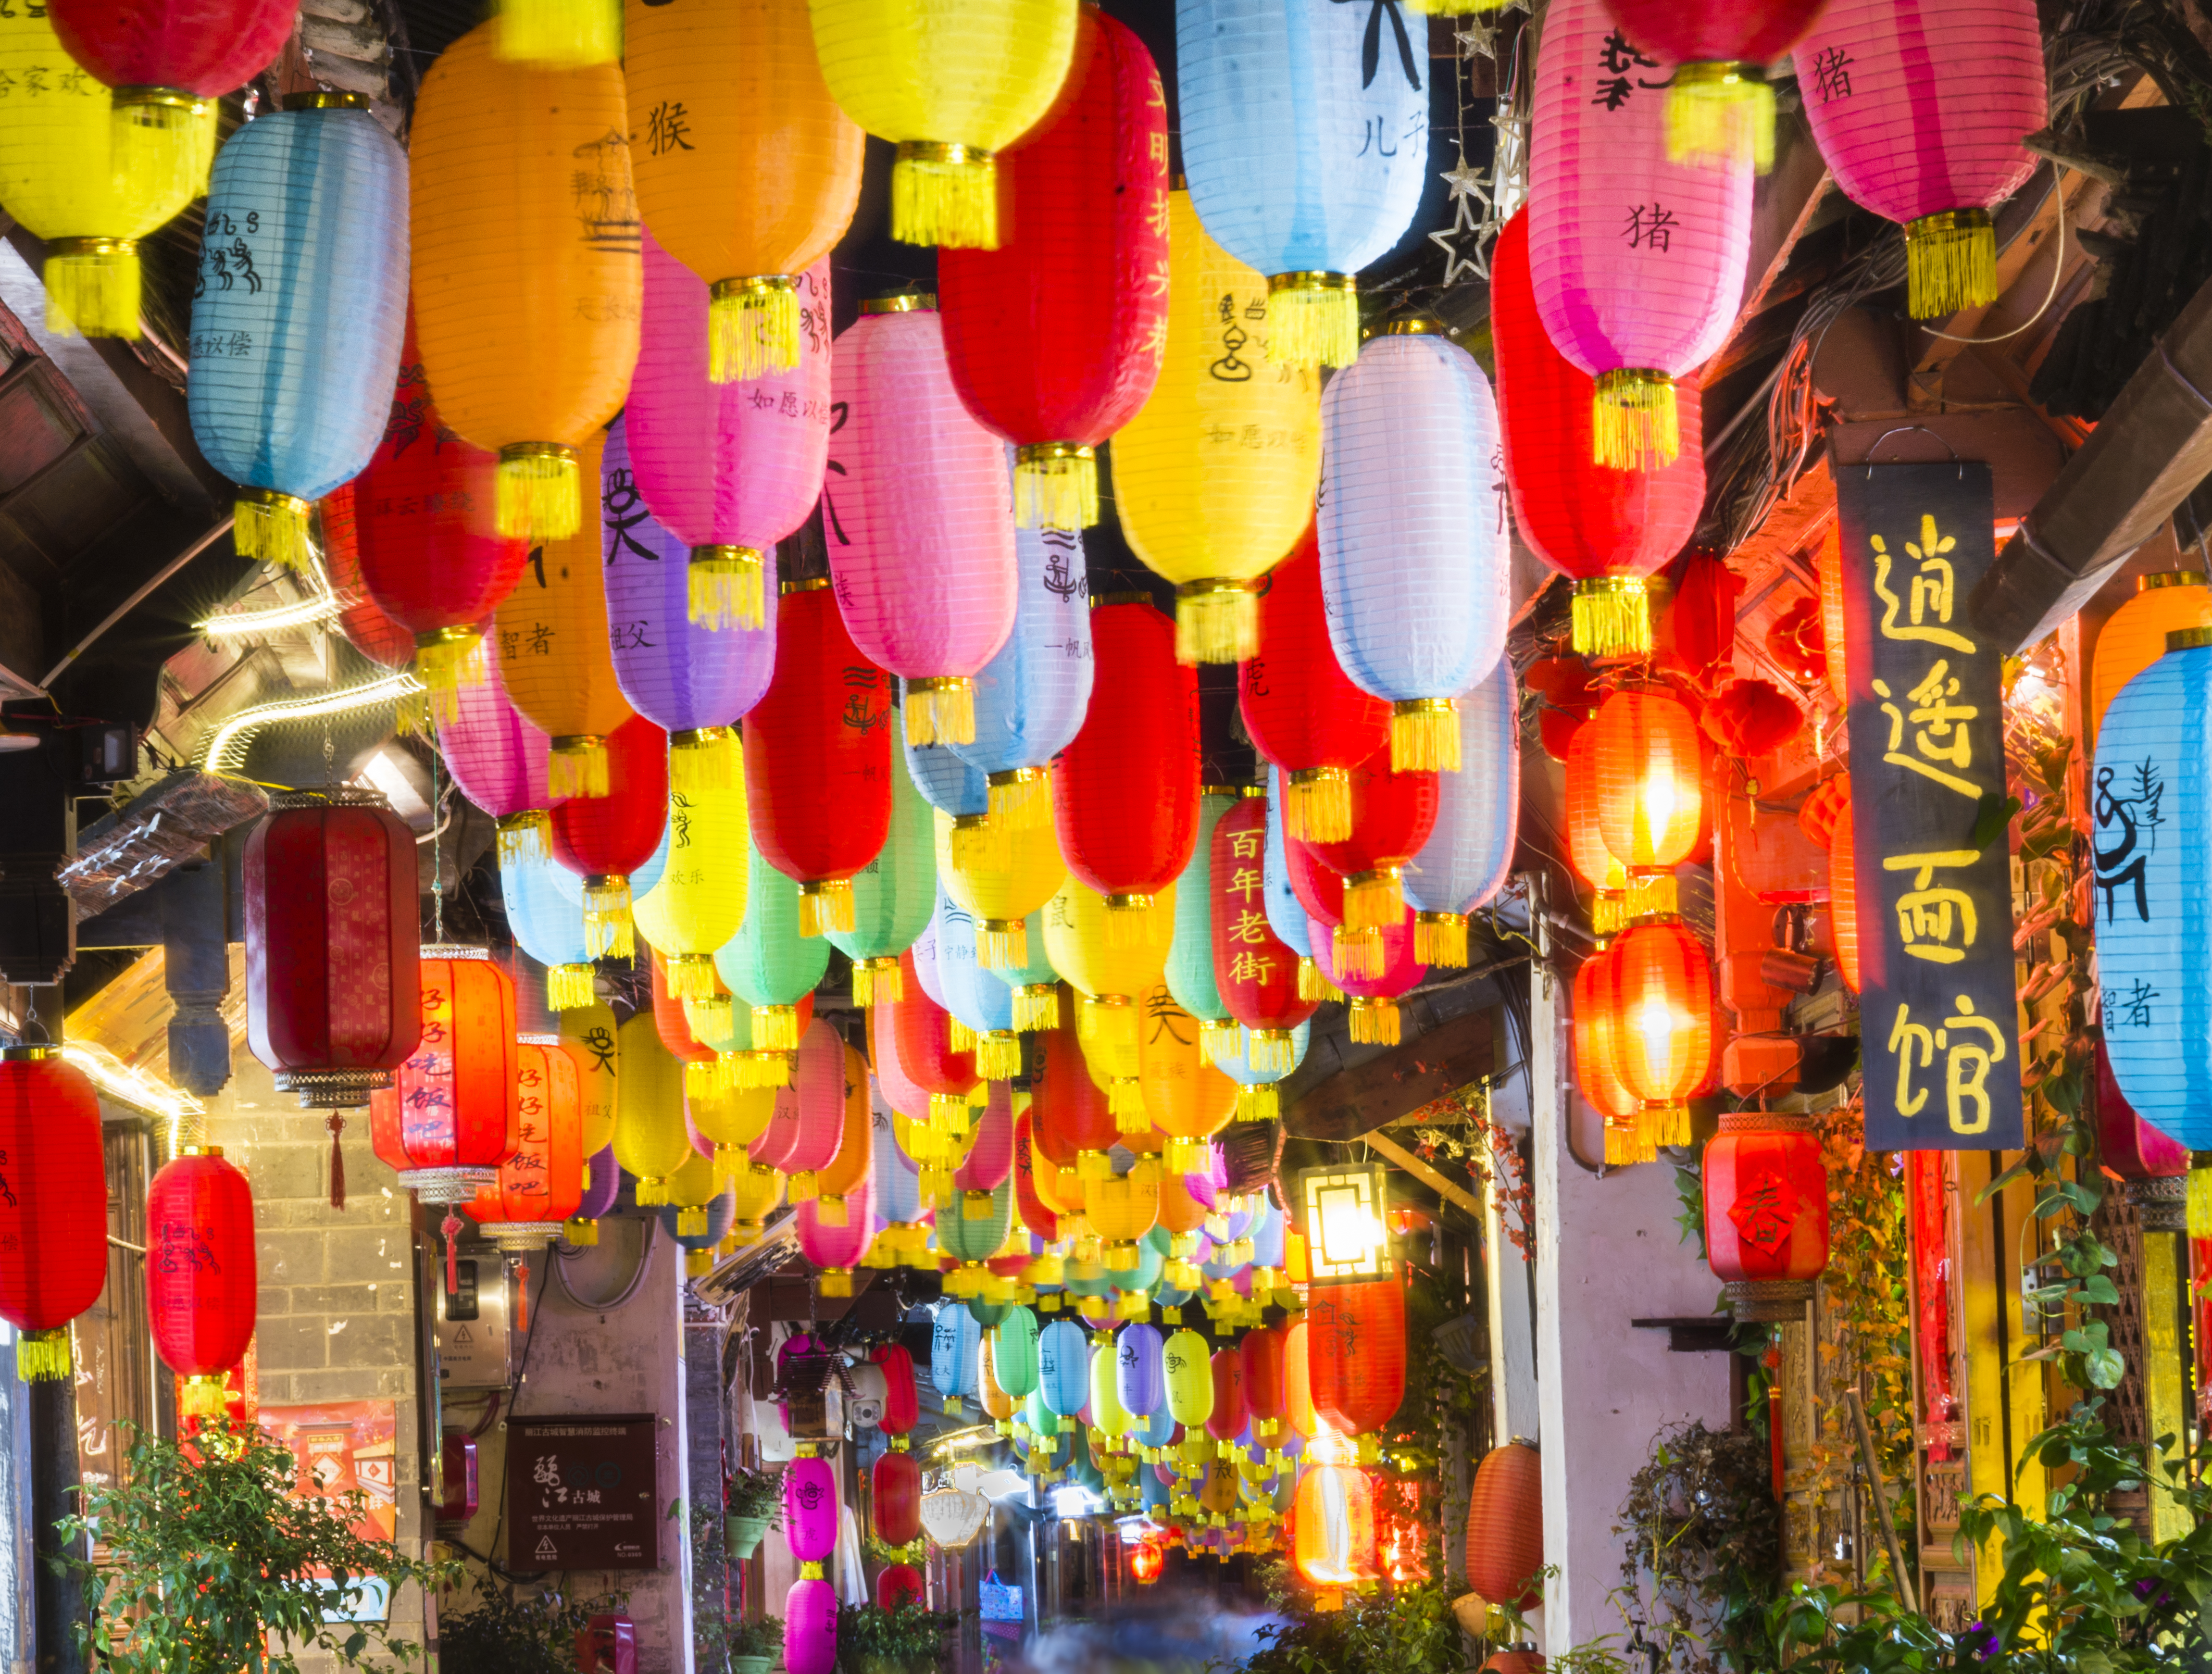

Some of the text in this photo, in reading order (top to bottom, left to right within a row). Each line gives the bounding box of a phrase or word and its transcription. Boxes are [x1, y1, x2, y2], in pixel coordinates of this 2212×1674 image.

[1814, 46, 1855, 103] 猪
[646, 100, 696, 156] 猴
[1357, 109, 1427, 159] 儿子
[1620, 202, 1680, 253] 猪
[501, 622, 556, 660] 智者
[1226, 829, 1276, 986] 百年老街
[2101, 977, 2160, 1033] 智者
[1744, 1179, 1791, 1245] 春
[1123, 1383, 1133, 1396] 牛
[525, 1427, 627, 1436] 丽江古城智慧消防监控终端
[531, 1513, 634, 1523] 世界文化遗产丽江古城保护管理局
[571, 1490, 601, 1504] 古城
